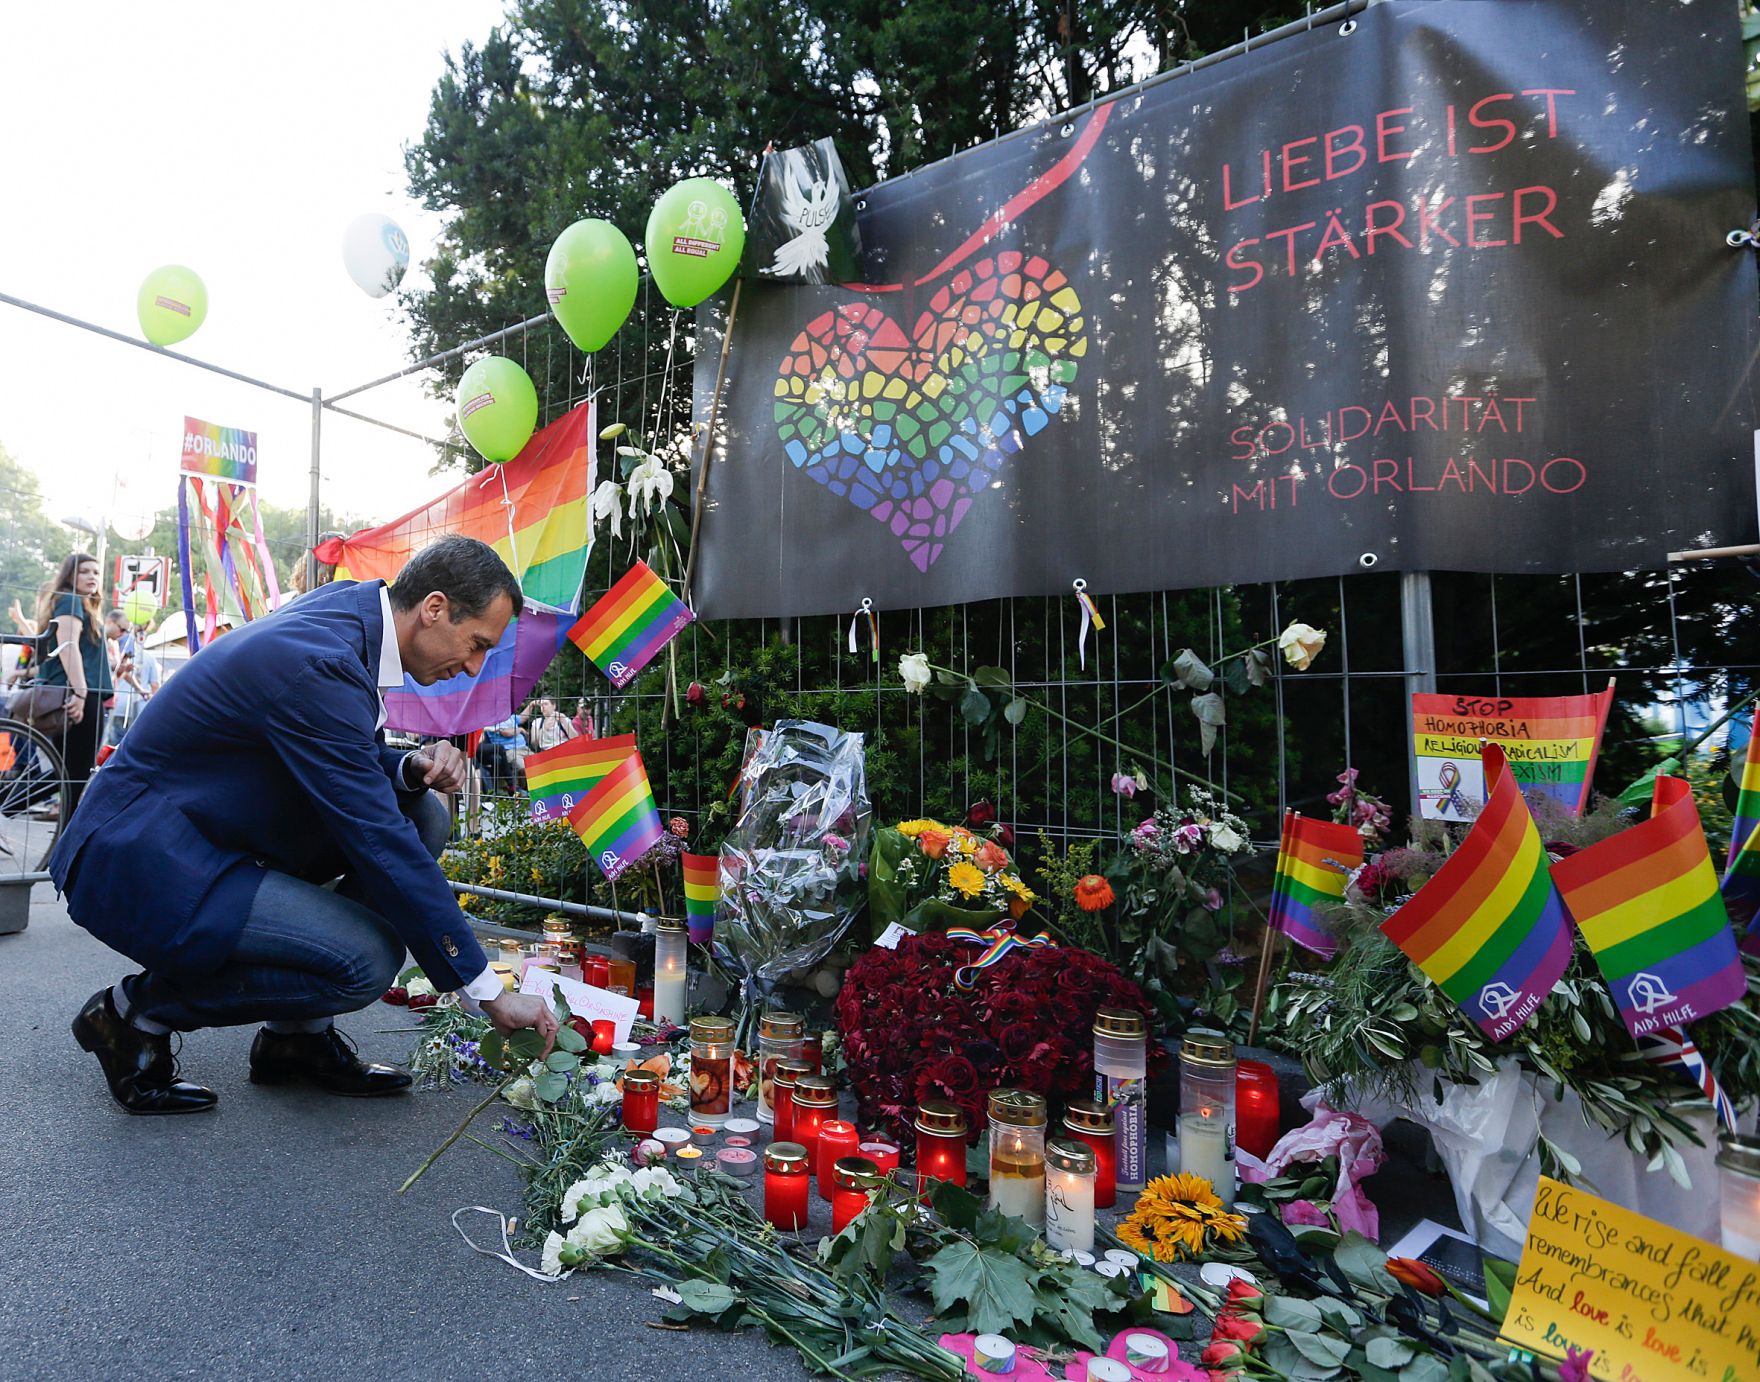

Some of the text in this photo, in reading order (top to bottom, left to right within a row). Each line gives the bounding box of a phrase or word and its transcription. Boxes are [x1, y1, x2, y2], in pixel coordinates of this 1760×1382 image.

[1222, 89, 1576, 211] LIEBE IST
[799, 206, 831, 228] PULSE
[1225, 184, 1566, 293] STÄRKER
[183, 432, 256, 466] #ORLANDO
[1230, 392, 1536, 460] SOLIDARITÄT
[1233, 457, 1587, 514] MIT ORLANDO
[1452, 697, 1514, 716] STOP
[1494, 993, 1541, 1038] AIDS HILFE
[1633, 1003, 1697, 1035] AIDS HILFE
[1129, 1104, 1138, 1180] HOMOPHOBIA
[1534, 1186, 1760, 1312] We rise and fall fr
[1528, 1232, 1675, 1322] remembrances
[1678, 1299, 1731, 1338] that
[1514, 1306, 1535, 1332] is
[1592, 1350, 1611, 1373] is
[1517, 1267, 1566, 1305] And
[1568, 1290, 1610, 1326] love
[1615, 1314, 1633, 1340] is
[1642, 1327, 1682, 1363] love
[1686, 1349, 1707, 1377] is
